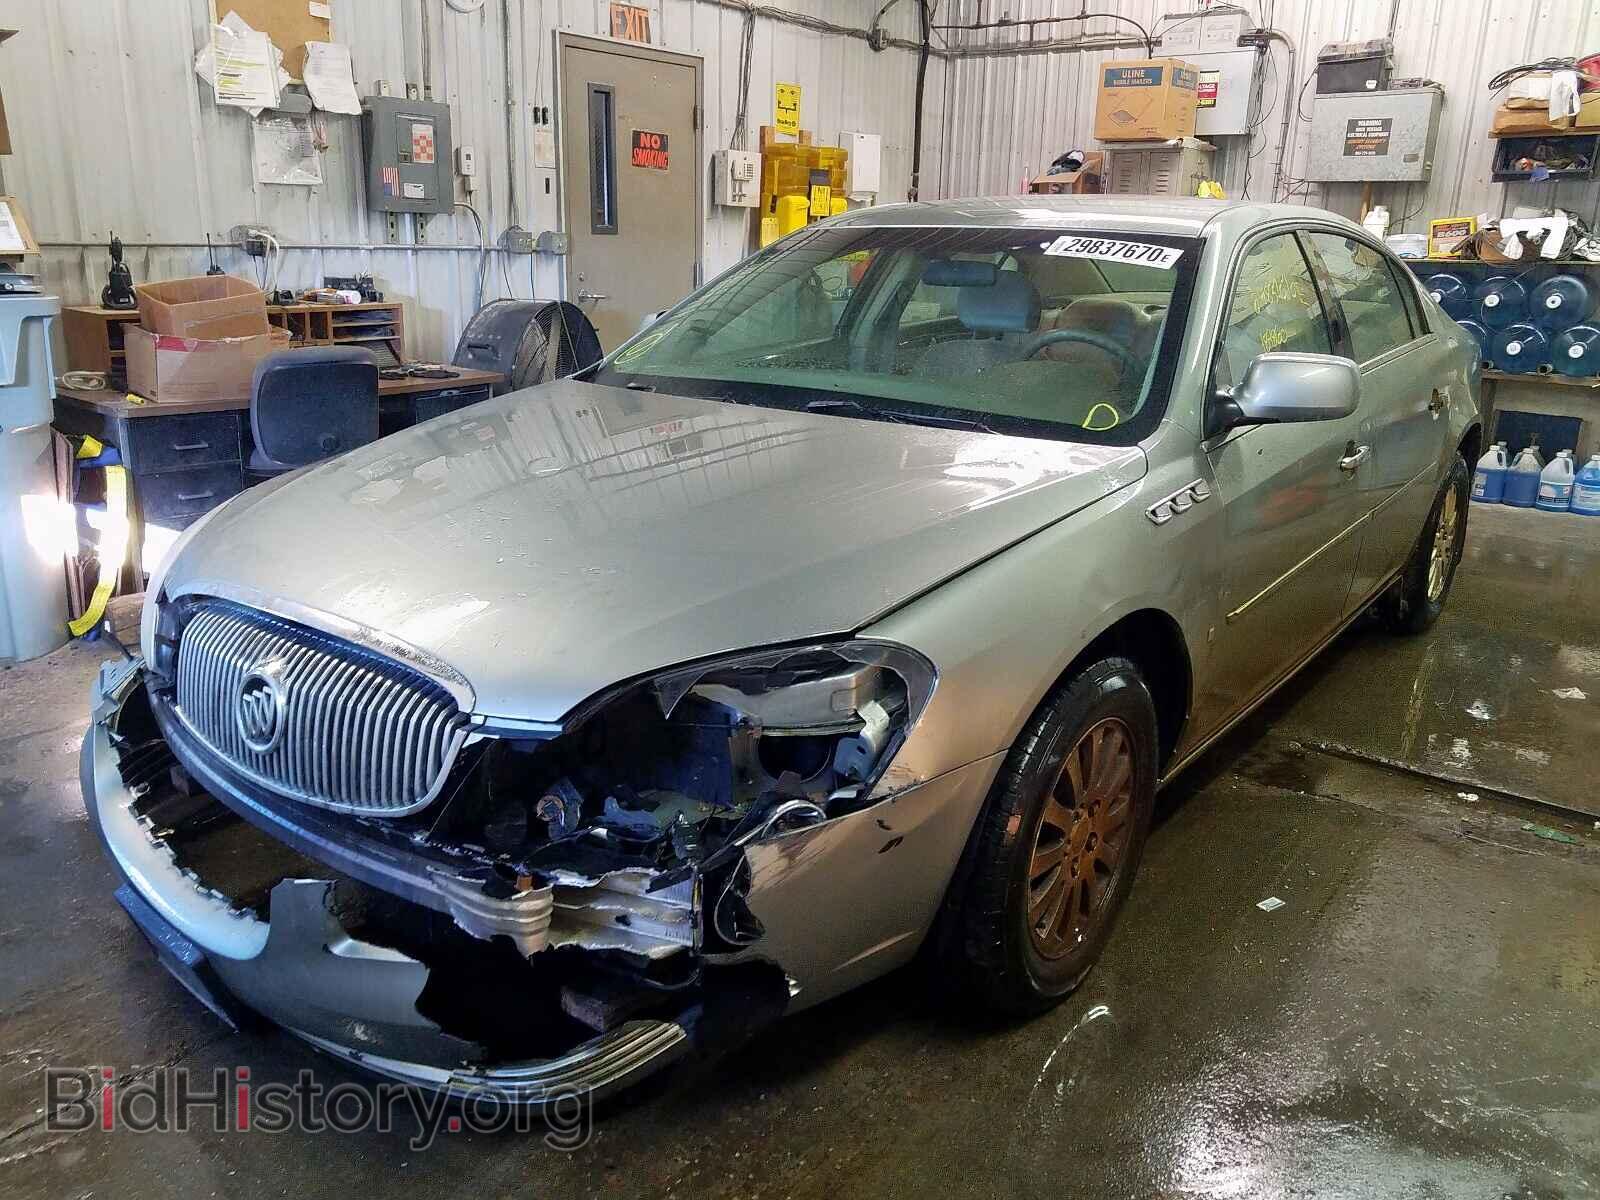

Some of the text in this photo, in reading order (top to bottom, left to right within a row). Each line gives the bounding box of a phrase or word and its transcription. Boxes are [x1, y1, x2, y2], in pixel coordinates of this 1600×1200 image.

[611, 5, 650, 42] EXIT
[1122, 69, 1145, 78] ULINE
[639, 132, 661, 149] NO
[632, 147, 670, 168] SMOKING
